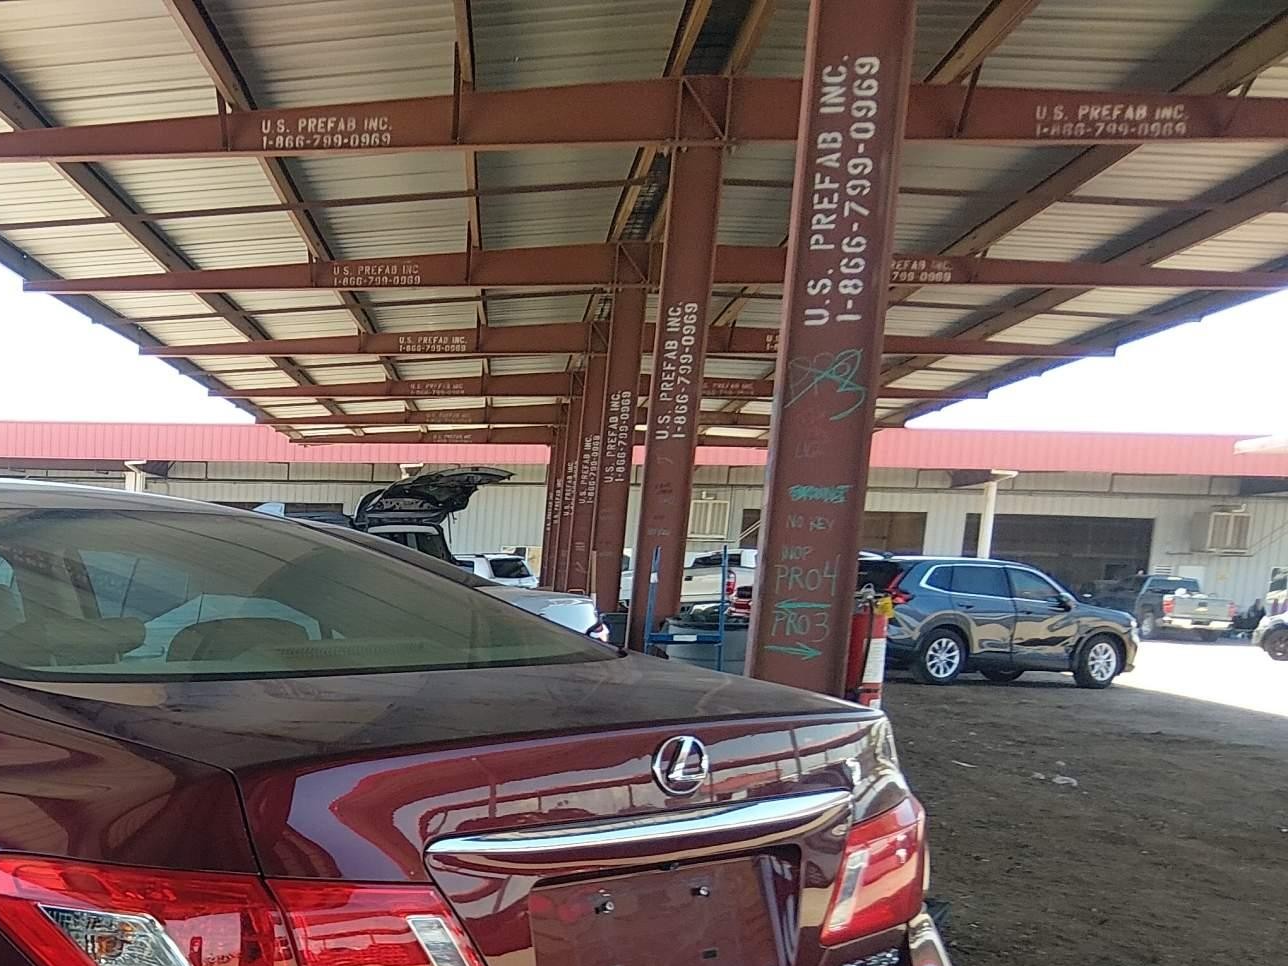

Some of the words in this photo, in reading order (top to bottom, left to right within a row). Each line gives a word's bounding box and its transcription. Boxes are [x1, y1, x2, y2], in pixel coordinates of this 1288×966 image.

[819, 55, 849, 114] INC.
[261, 119, 290, 134] U.S.
[297, 117, 357, 132] PREFAB
[363, 116, 393, 131] INC.
[1078, 104, 1148, 121] PREFAB
[262, 133, 391, 150] 1-866-799-0969
[809, 131, 843, 250] PREFAB
[836, 56, 881, 322] 1-866-799-0969
[357, 265, 398, 275] PREFAB
[666, 301, 684, 332] INC.
[804, 267, 834, 326] U.S.
[660, 340, 679, 401] PREFAB
[672, 302, 698, 438] 1-866-799-0969
[606, 416, 619, 457] PREFAB
[655, 410, 672, 440] U.S.
